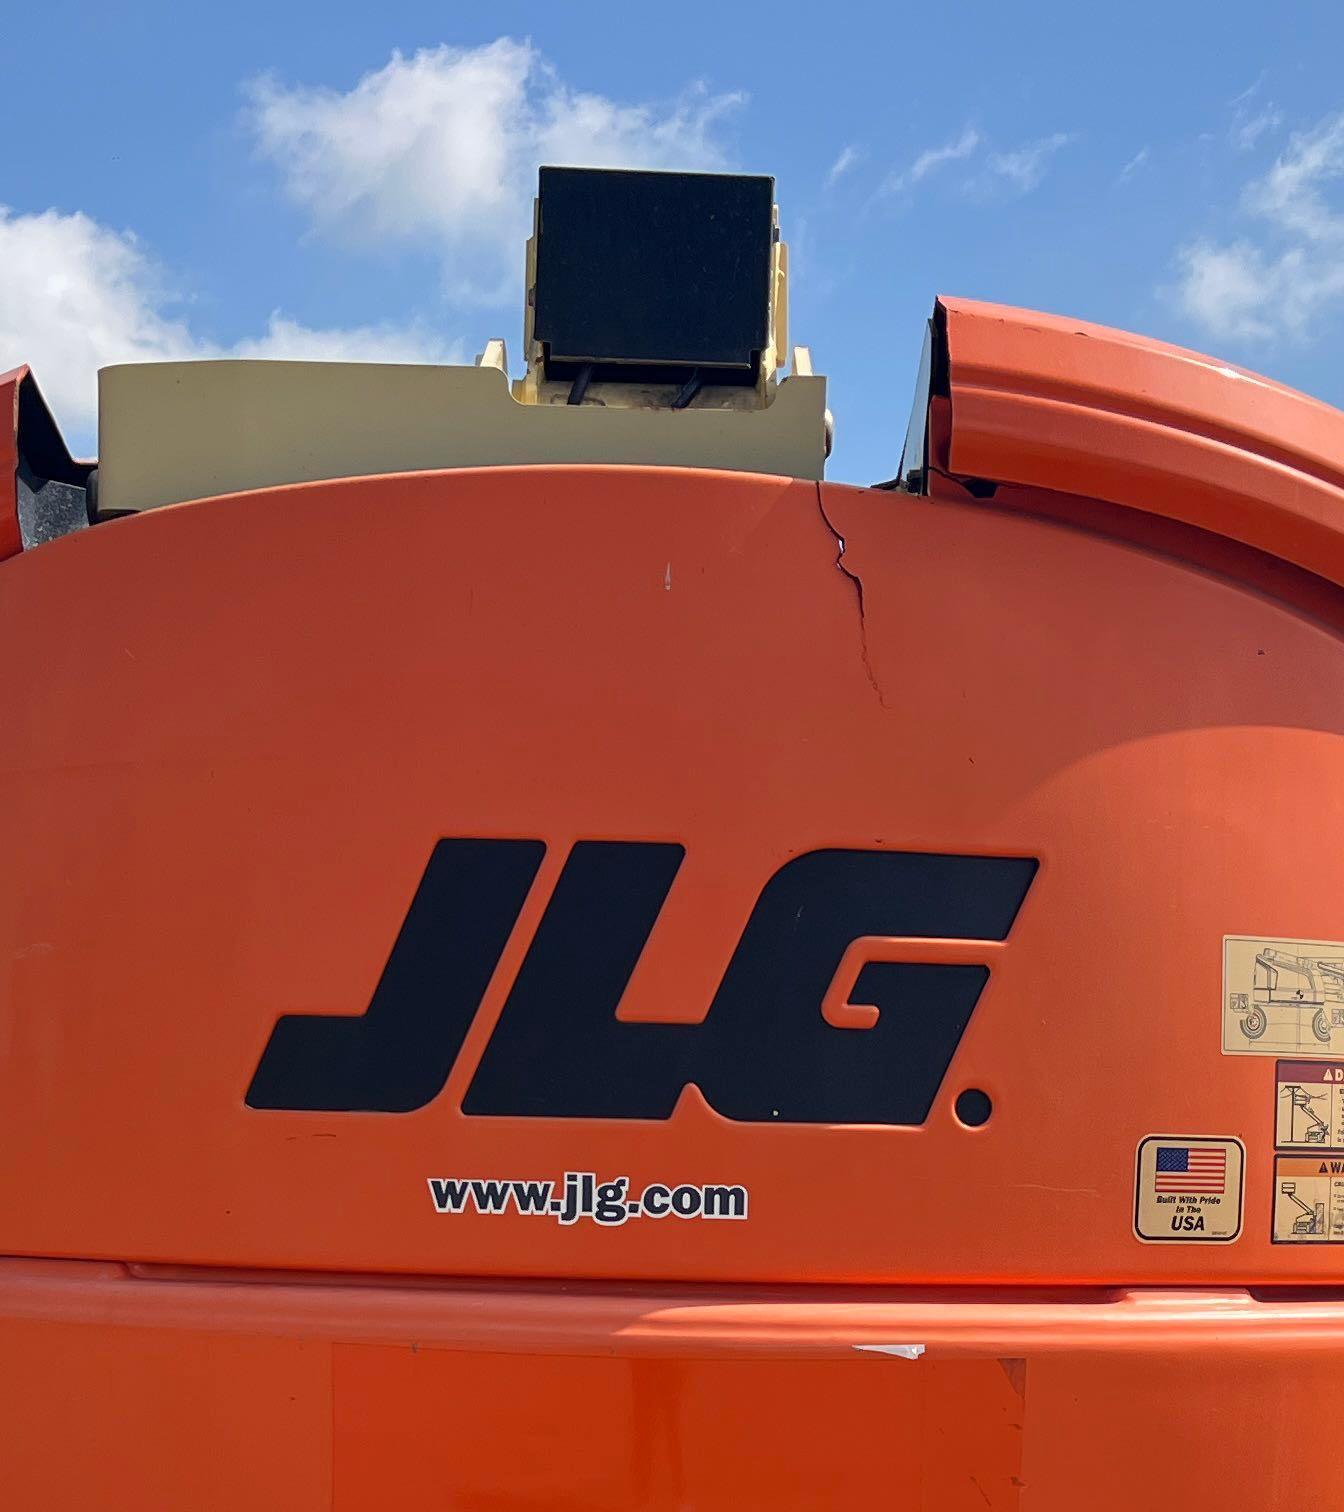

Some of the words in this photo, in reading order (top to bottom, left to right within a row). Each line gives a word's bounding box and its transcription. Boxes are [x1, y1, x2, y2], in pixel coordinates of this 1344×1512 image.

[428, 1172, 747, 1225] www.jlg.com
[1156, 1195, 1176, 1204] Built
[1179, 1196, 1197, 1204] With
[1199, 1195, 1221, 1205] Pride
[1186, 1205, 1201, 1214] The
[1171, 1215, 1205, 1231] USA
